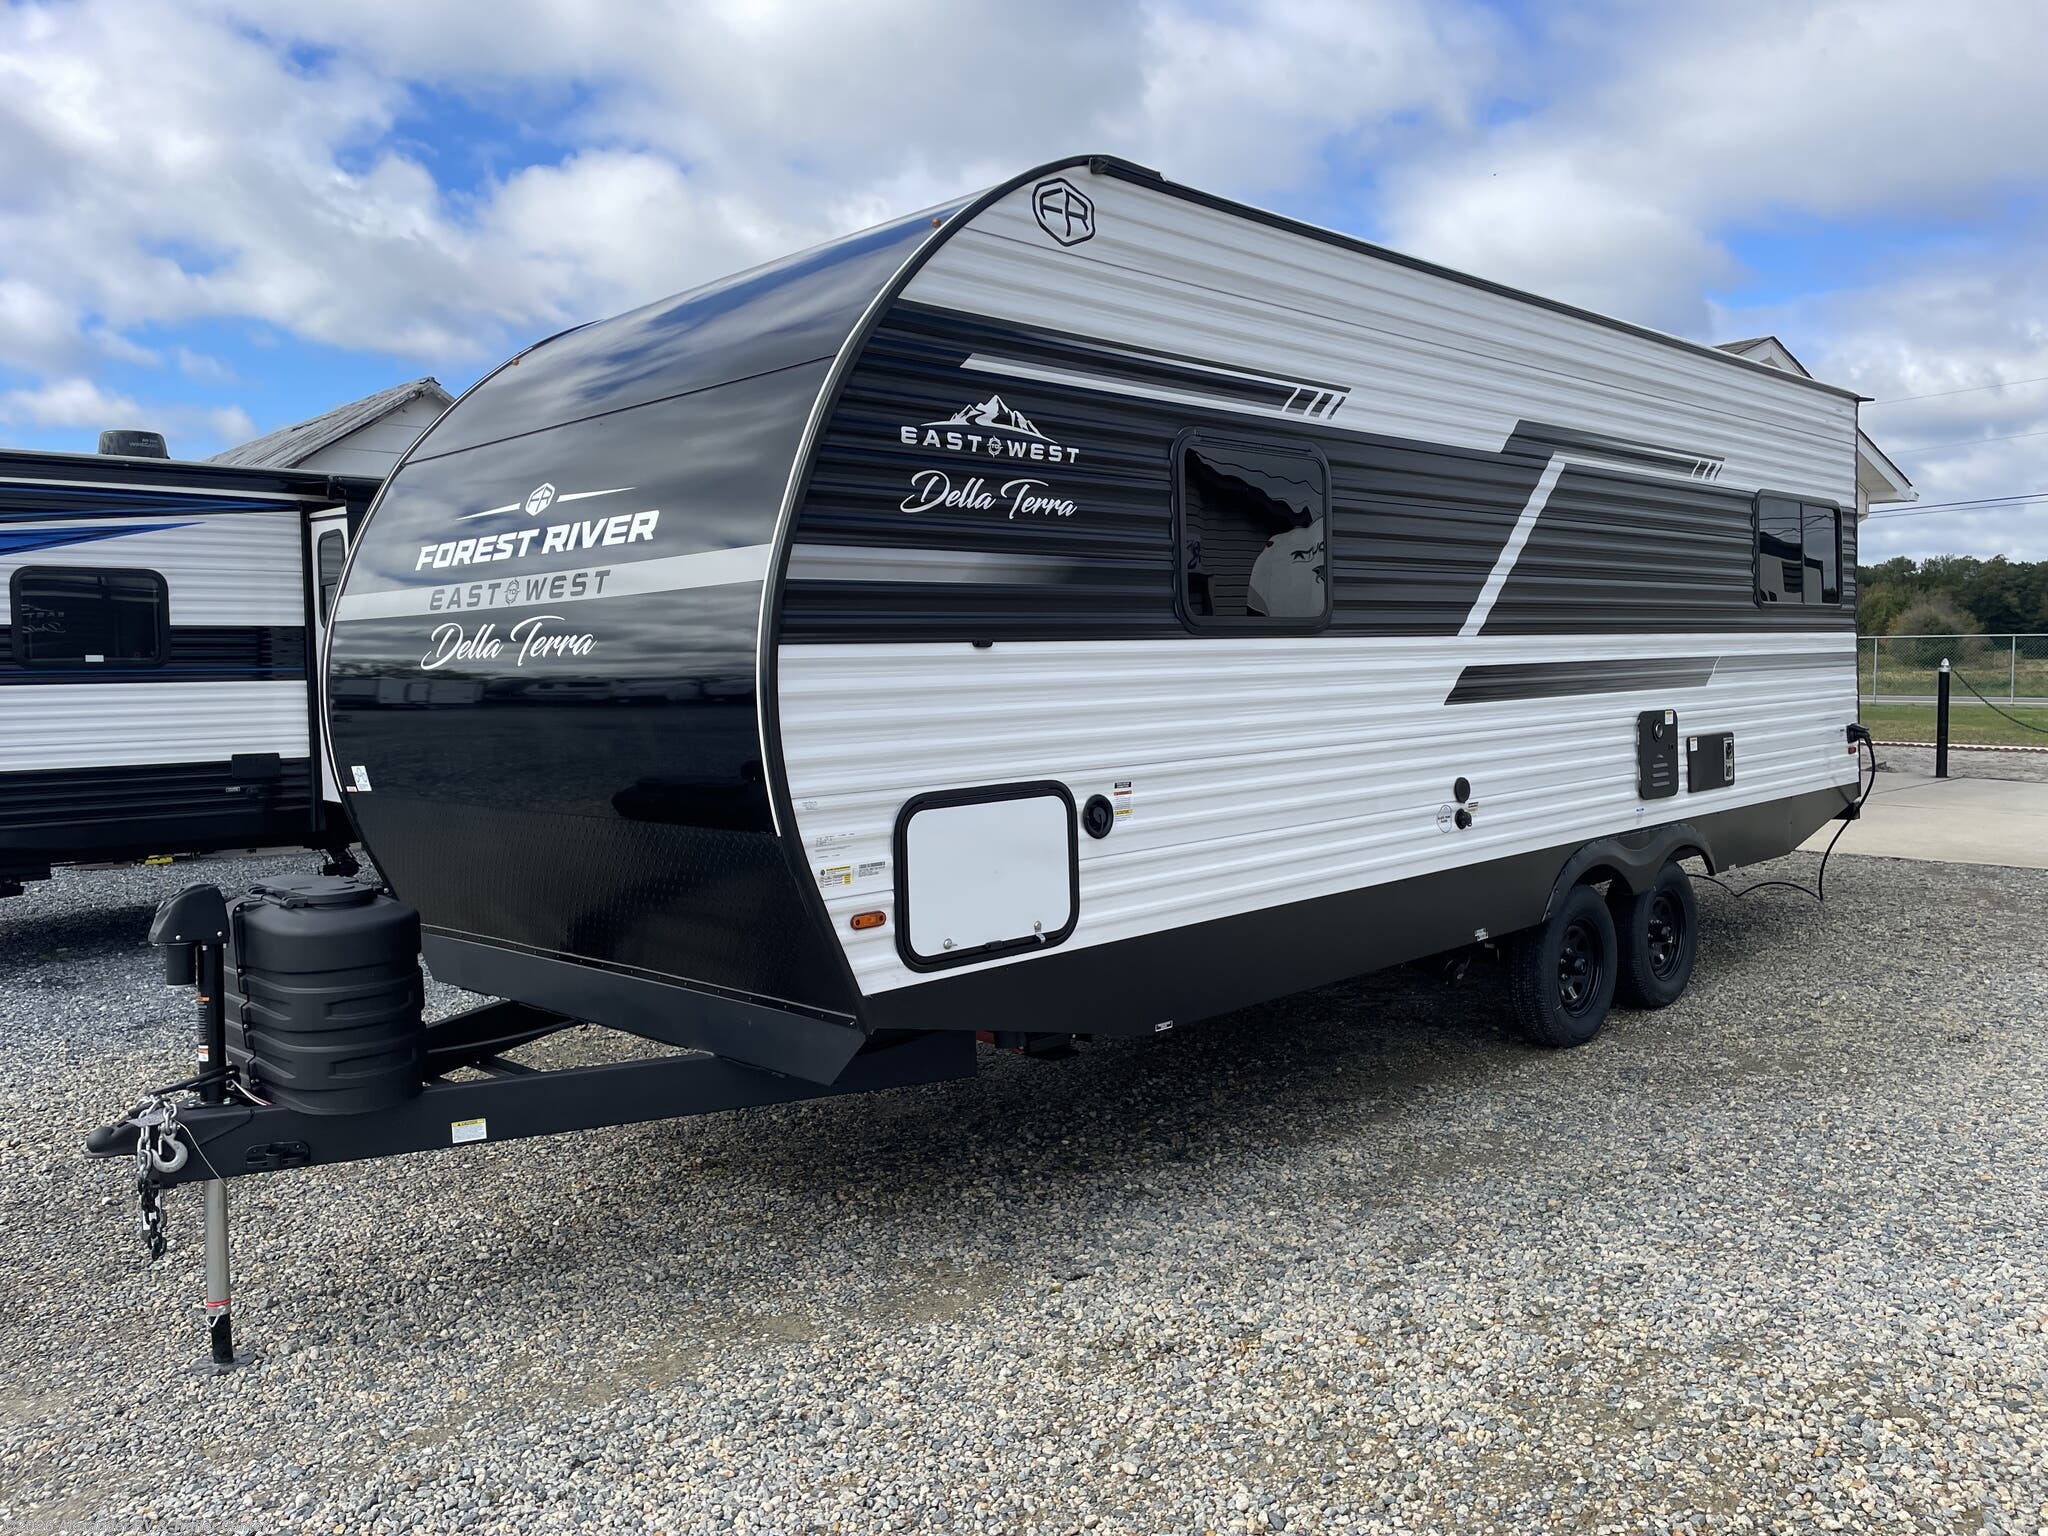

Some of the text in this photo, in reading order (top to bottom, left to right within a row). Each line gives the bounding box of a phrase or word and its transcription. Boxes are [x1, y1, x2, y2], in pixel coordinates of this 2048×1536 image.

[900, 425, 983, 454] EAST
[1006, 440, 1080, 464] WEST
[900, 469, 1078, 520] Della Terra
[414, 510, 660, 572] FOREST RIVER
[429, 582, 502, 611] EAST
[526, 569, 611, 602] WEST
[420, 615, 598, 670] Della Terra
